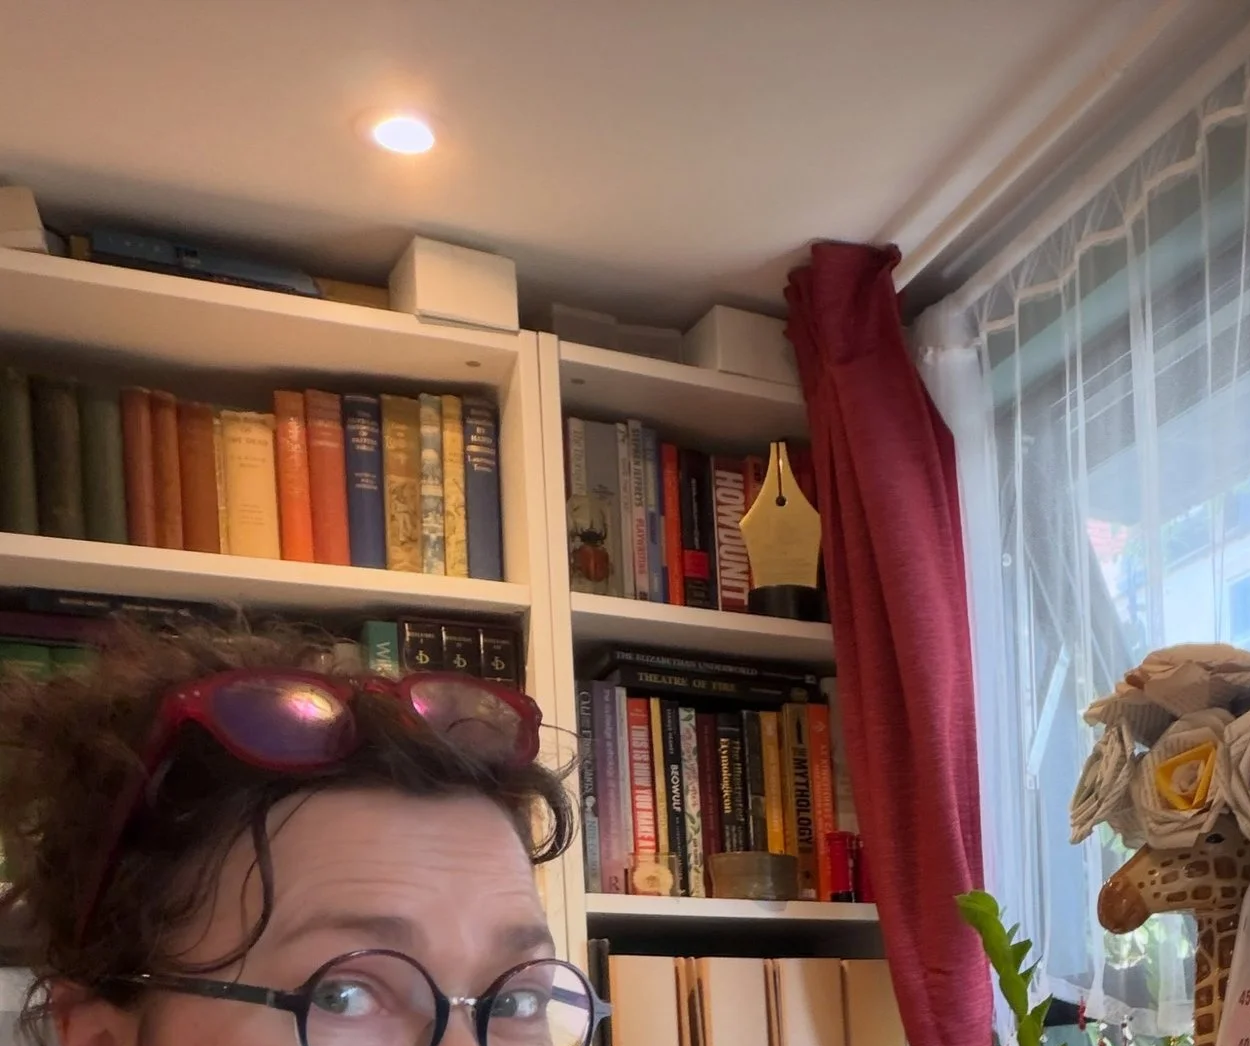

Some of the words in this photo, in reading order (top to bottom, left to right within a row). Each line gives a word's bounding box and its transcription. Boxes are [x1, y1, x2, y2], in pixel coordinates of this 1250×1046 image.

[715, 469, 749, 606] HOWDUNIT
[637, 671, 689, 687] THEATRE
[692, 679, 707, 689] OF
[631, 725, 650, 747] THIS
[632, 749, 651, 760] IS
[670, 764, 681, 812] BEOWULF
[719, 737, 733, 814] Etymologicon
[635, 788, 653, 808] YOU
[793, 757, 813, 845] MYTHOLOGY
[636, 810, 655, 839] MAKE
